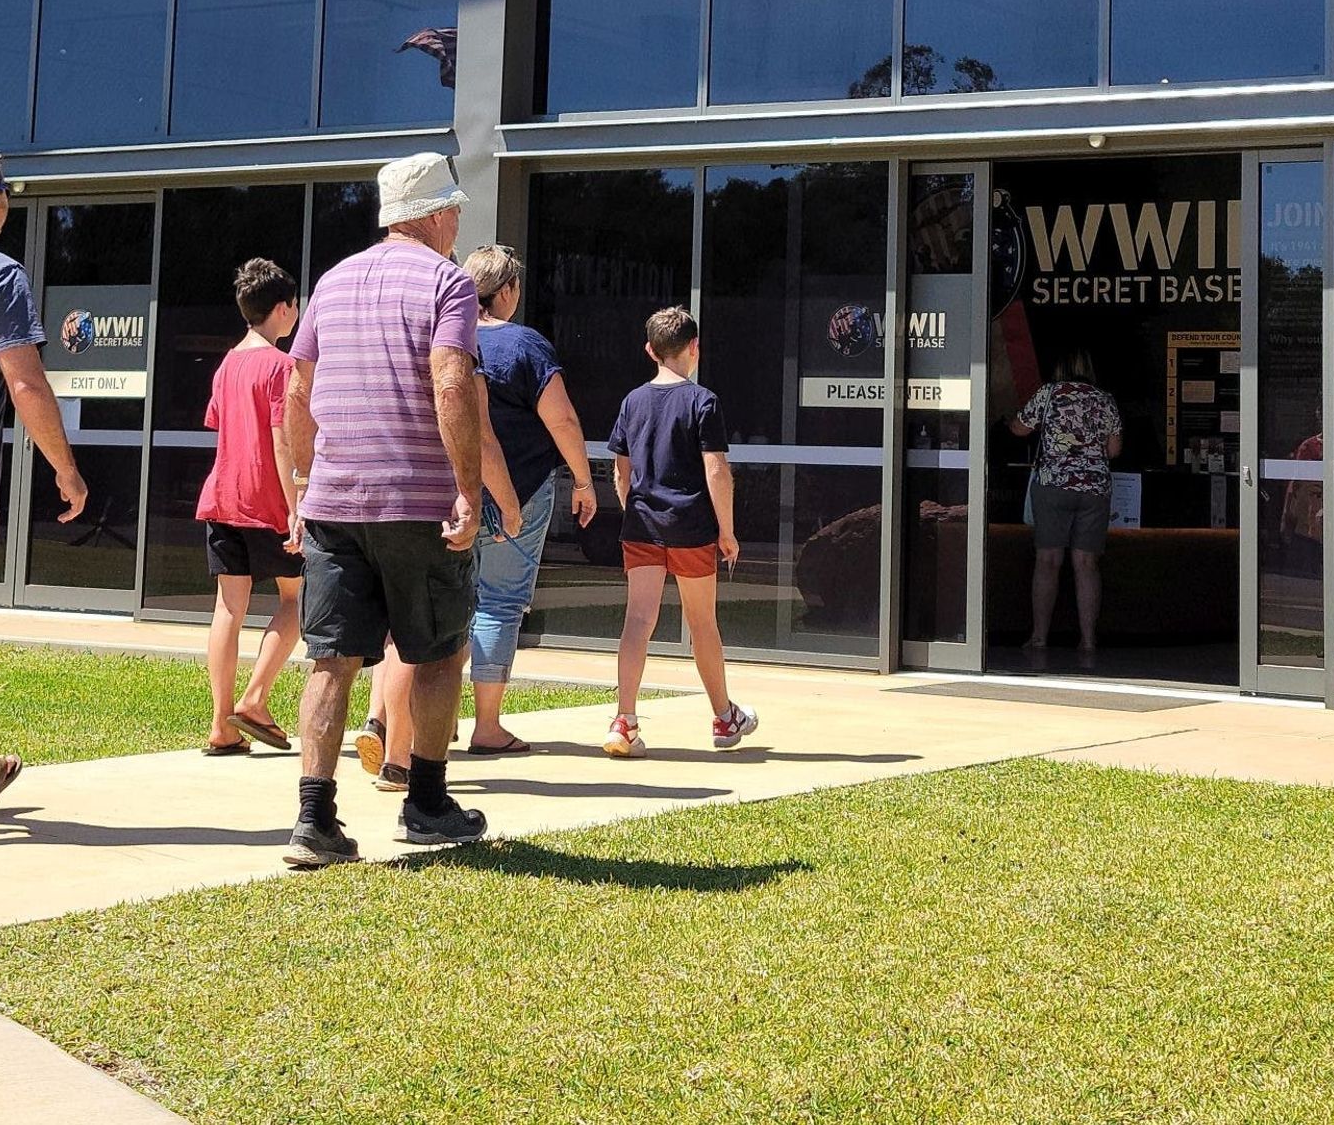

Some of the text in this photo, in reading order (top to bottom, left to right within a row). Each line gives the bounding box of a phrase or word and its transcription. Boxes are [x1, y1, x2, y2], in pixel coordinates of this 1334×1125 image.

[1025, 199, 1241, 271] WWII
[1032, 276, 1152, 304] SECRET
[1160, 275, 1241, 303] BASE
[94, 316, 143, 338] WWII
[93, 337, 143, 347] SECRET BASE
[917, 338, 945, 348] BASE
[70, 377, 127, 390] EXIT ONLY
[827, 383, 943, 401] PLEASE TER
[1169, 388, 1174, 396] 2
